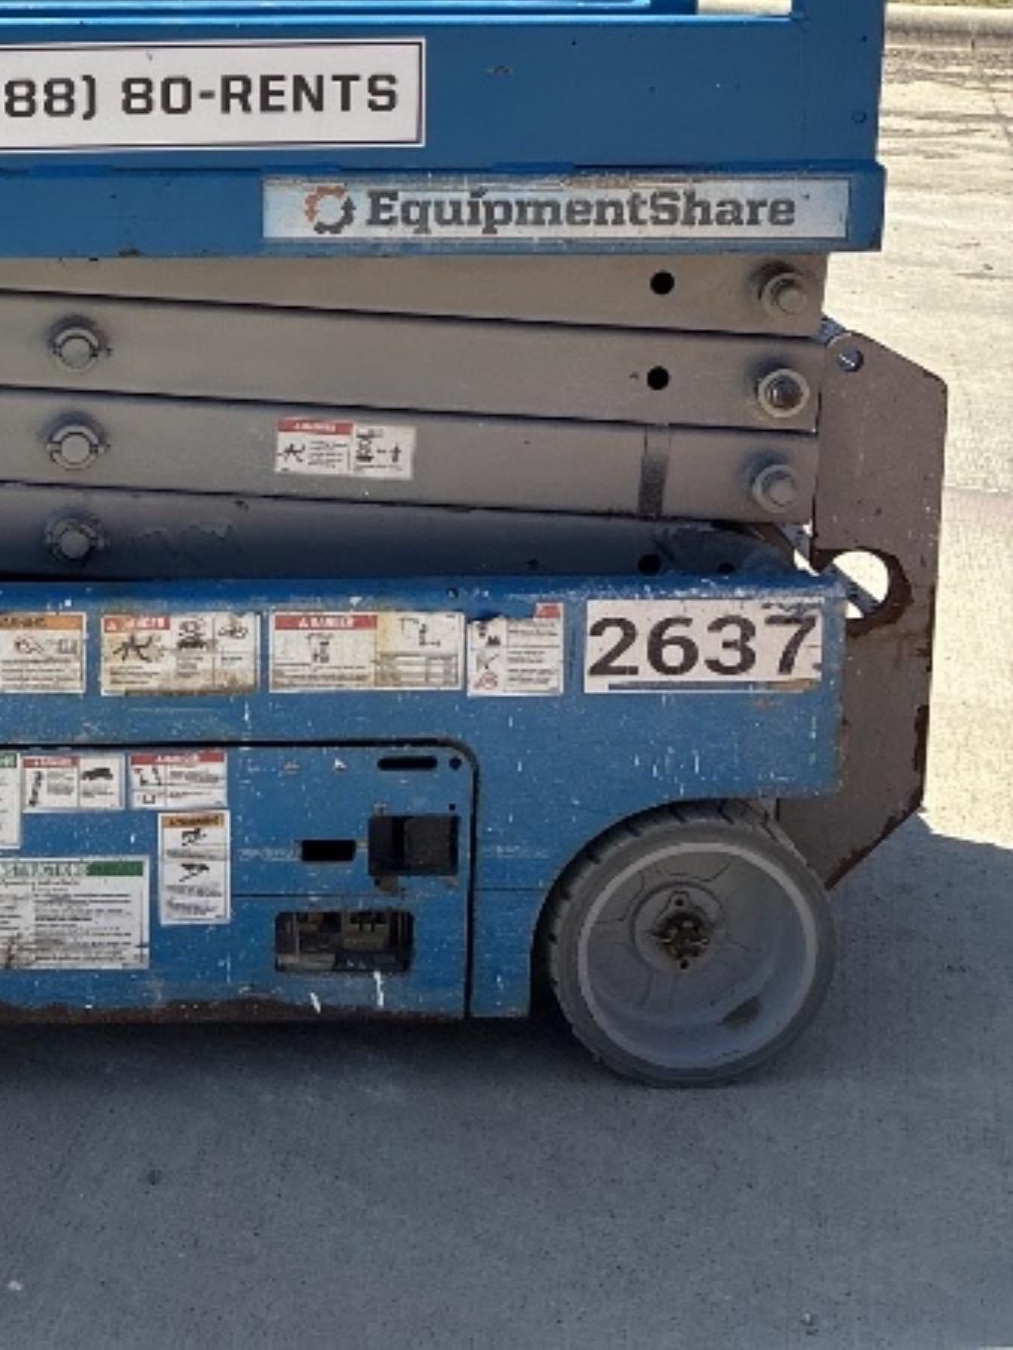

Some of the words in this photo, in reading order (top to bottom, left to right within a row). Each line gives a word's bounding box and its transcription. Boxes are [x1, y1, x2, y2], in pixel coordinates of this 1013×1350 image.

[121, 72, 399, 116] 80-RENTS
[366, 187, 797, 235] EquipmentShare
[588, 614, 818, 676] 2637
